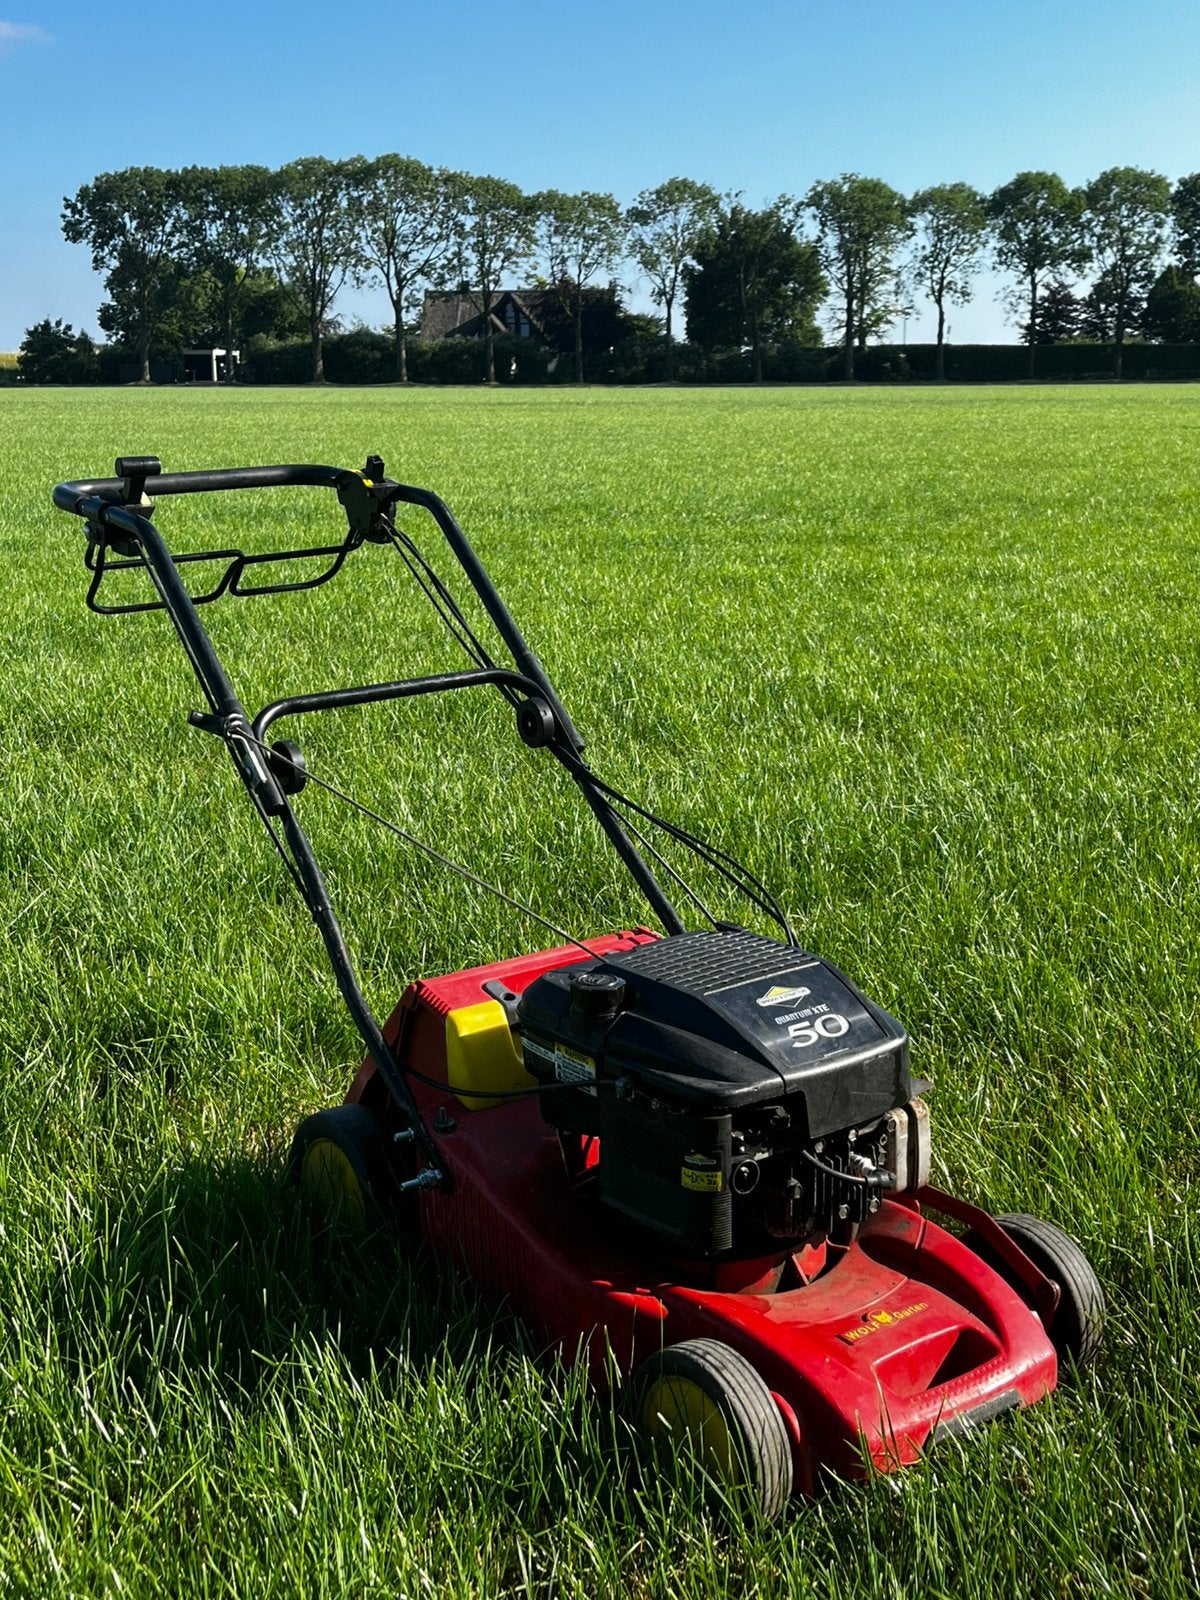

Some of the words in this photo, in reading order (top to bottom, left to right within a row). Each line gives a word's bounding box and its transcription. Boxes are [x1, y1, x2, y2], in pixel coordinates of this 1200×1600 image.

[774, 1008, 813, 1025] QUANTUM
[811, 1003, 830, 1014] XTE
[787, 1013, 850, 1048] 50
[844, 1321, 881, 1341] WOLF
[892, 1302, 929, 1319] Garten
